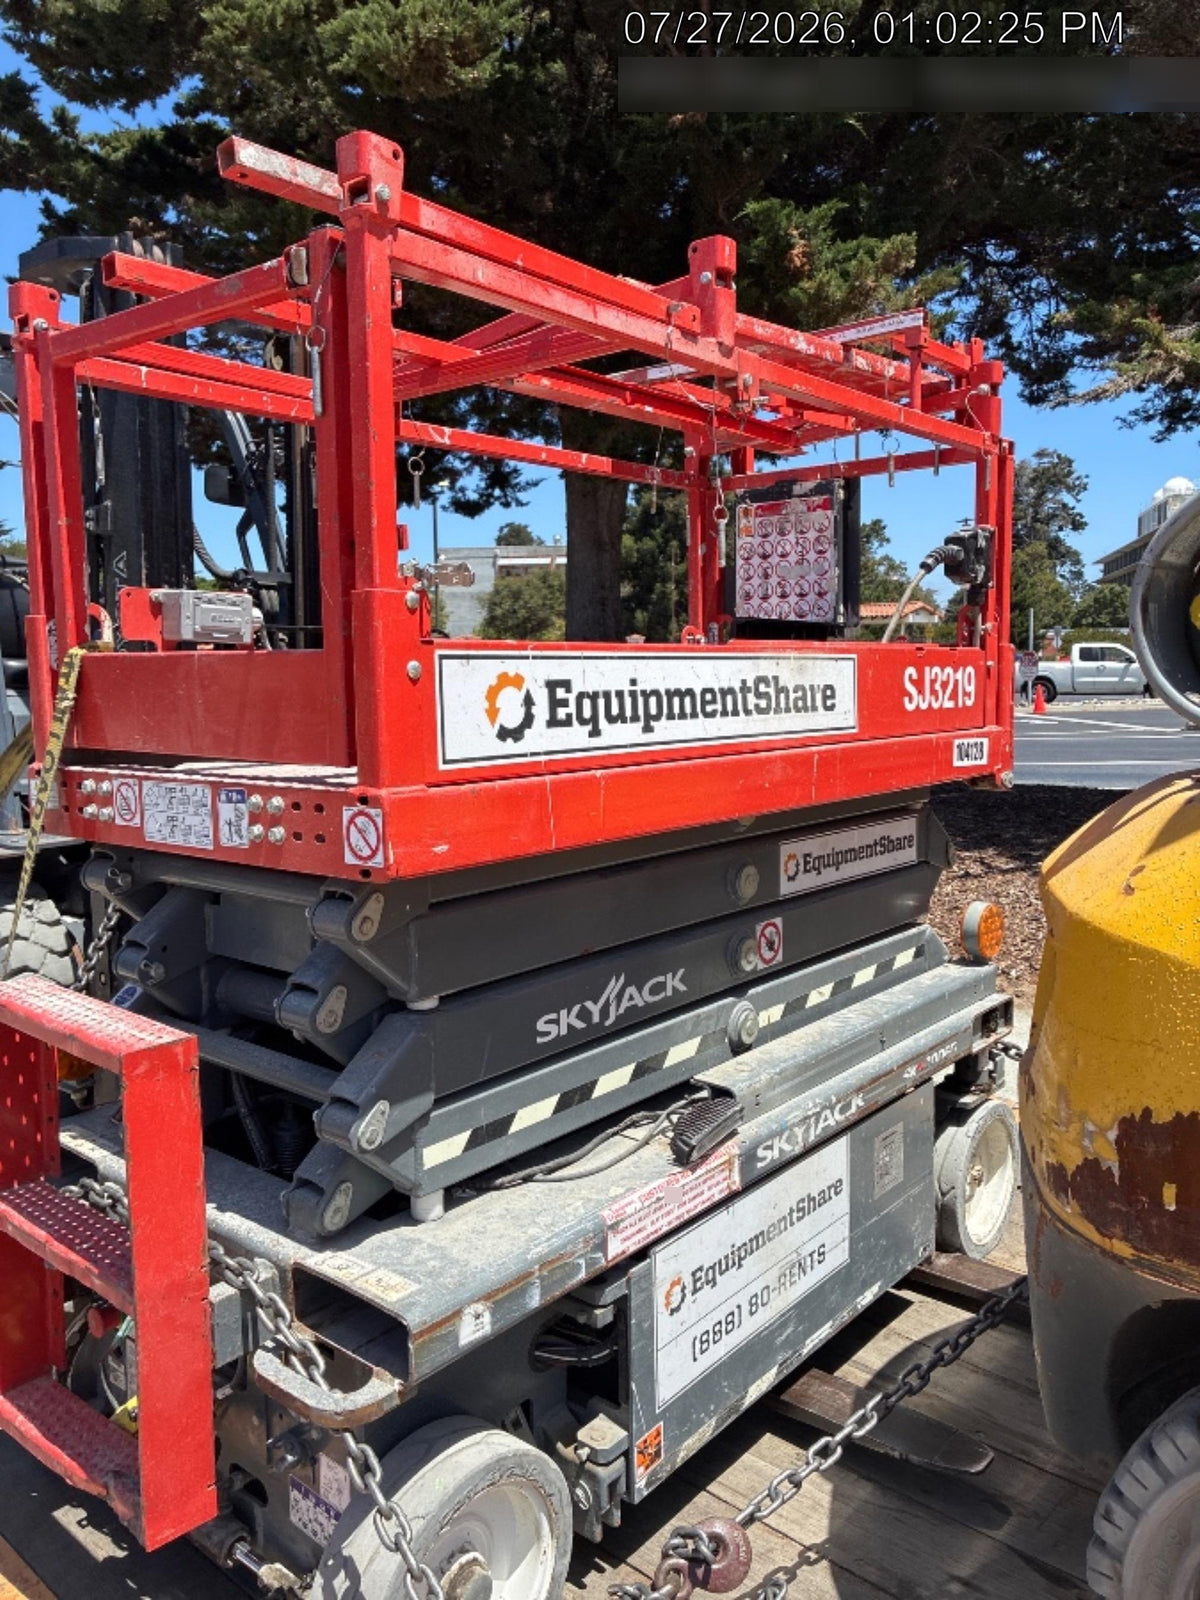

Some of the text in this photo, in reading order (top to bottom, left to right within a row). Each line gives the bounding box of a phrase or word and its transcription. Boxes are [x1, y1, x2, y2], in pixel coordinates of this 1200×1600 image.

[545, 675, 837, 738] EquipmentShare
[902, 665, 976, 712] SJ3219
[802, 833, 915, 875] EquipmentShare
[535, 967, 688, 1045] SKYJACK
[691, 1178, 844, 1296] EquipmentShare
[691, 1243, 826, 1363] (888) 80-RENTS
